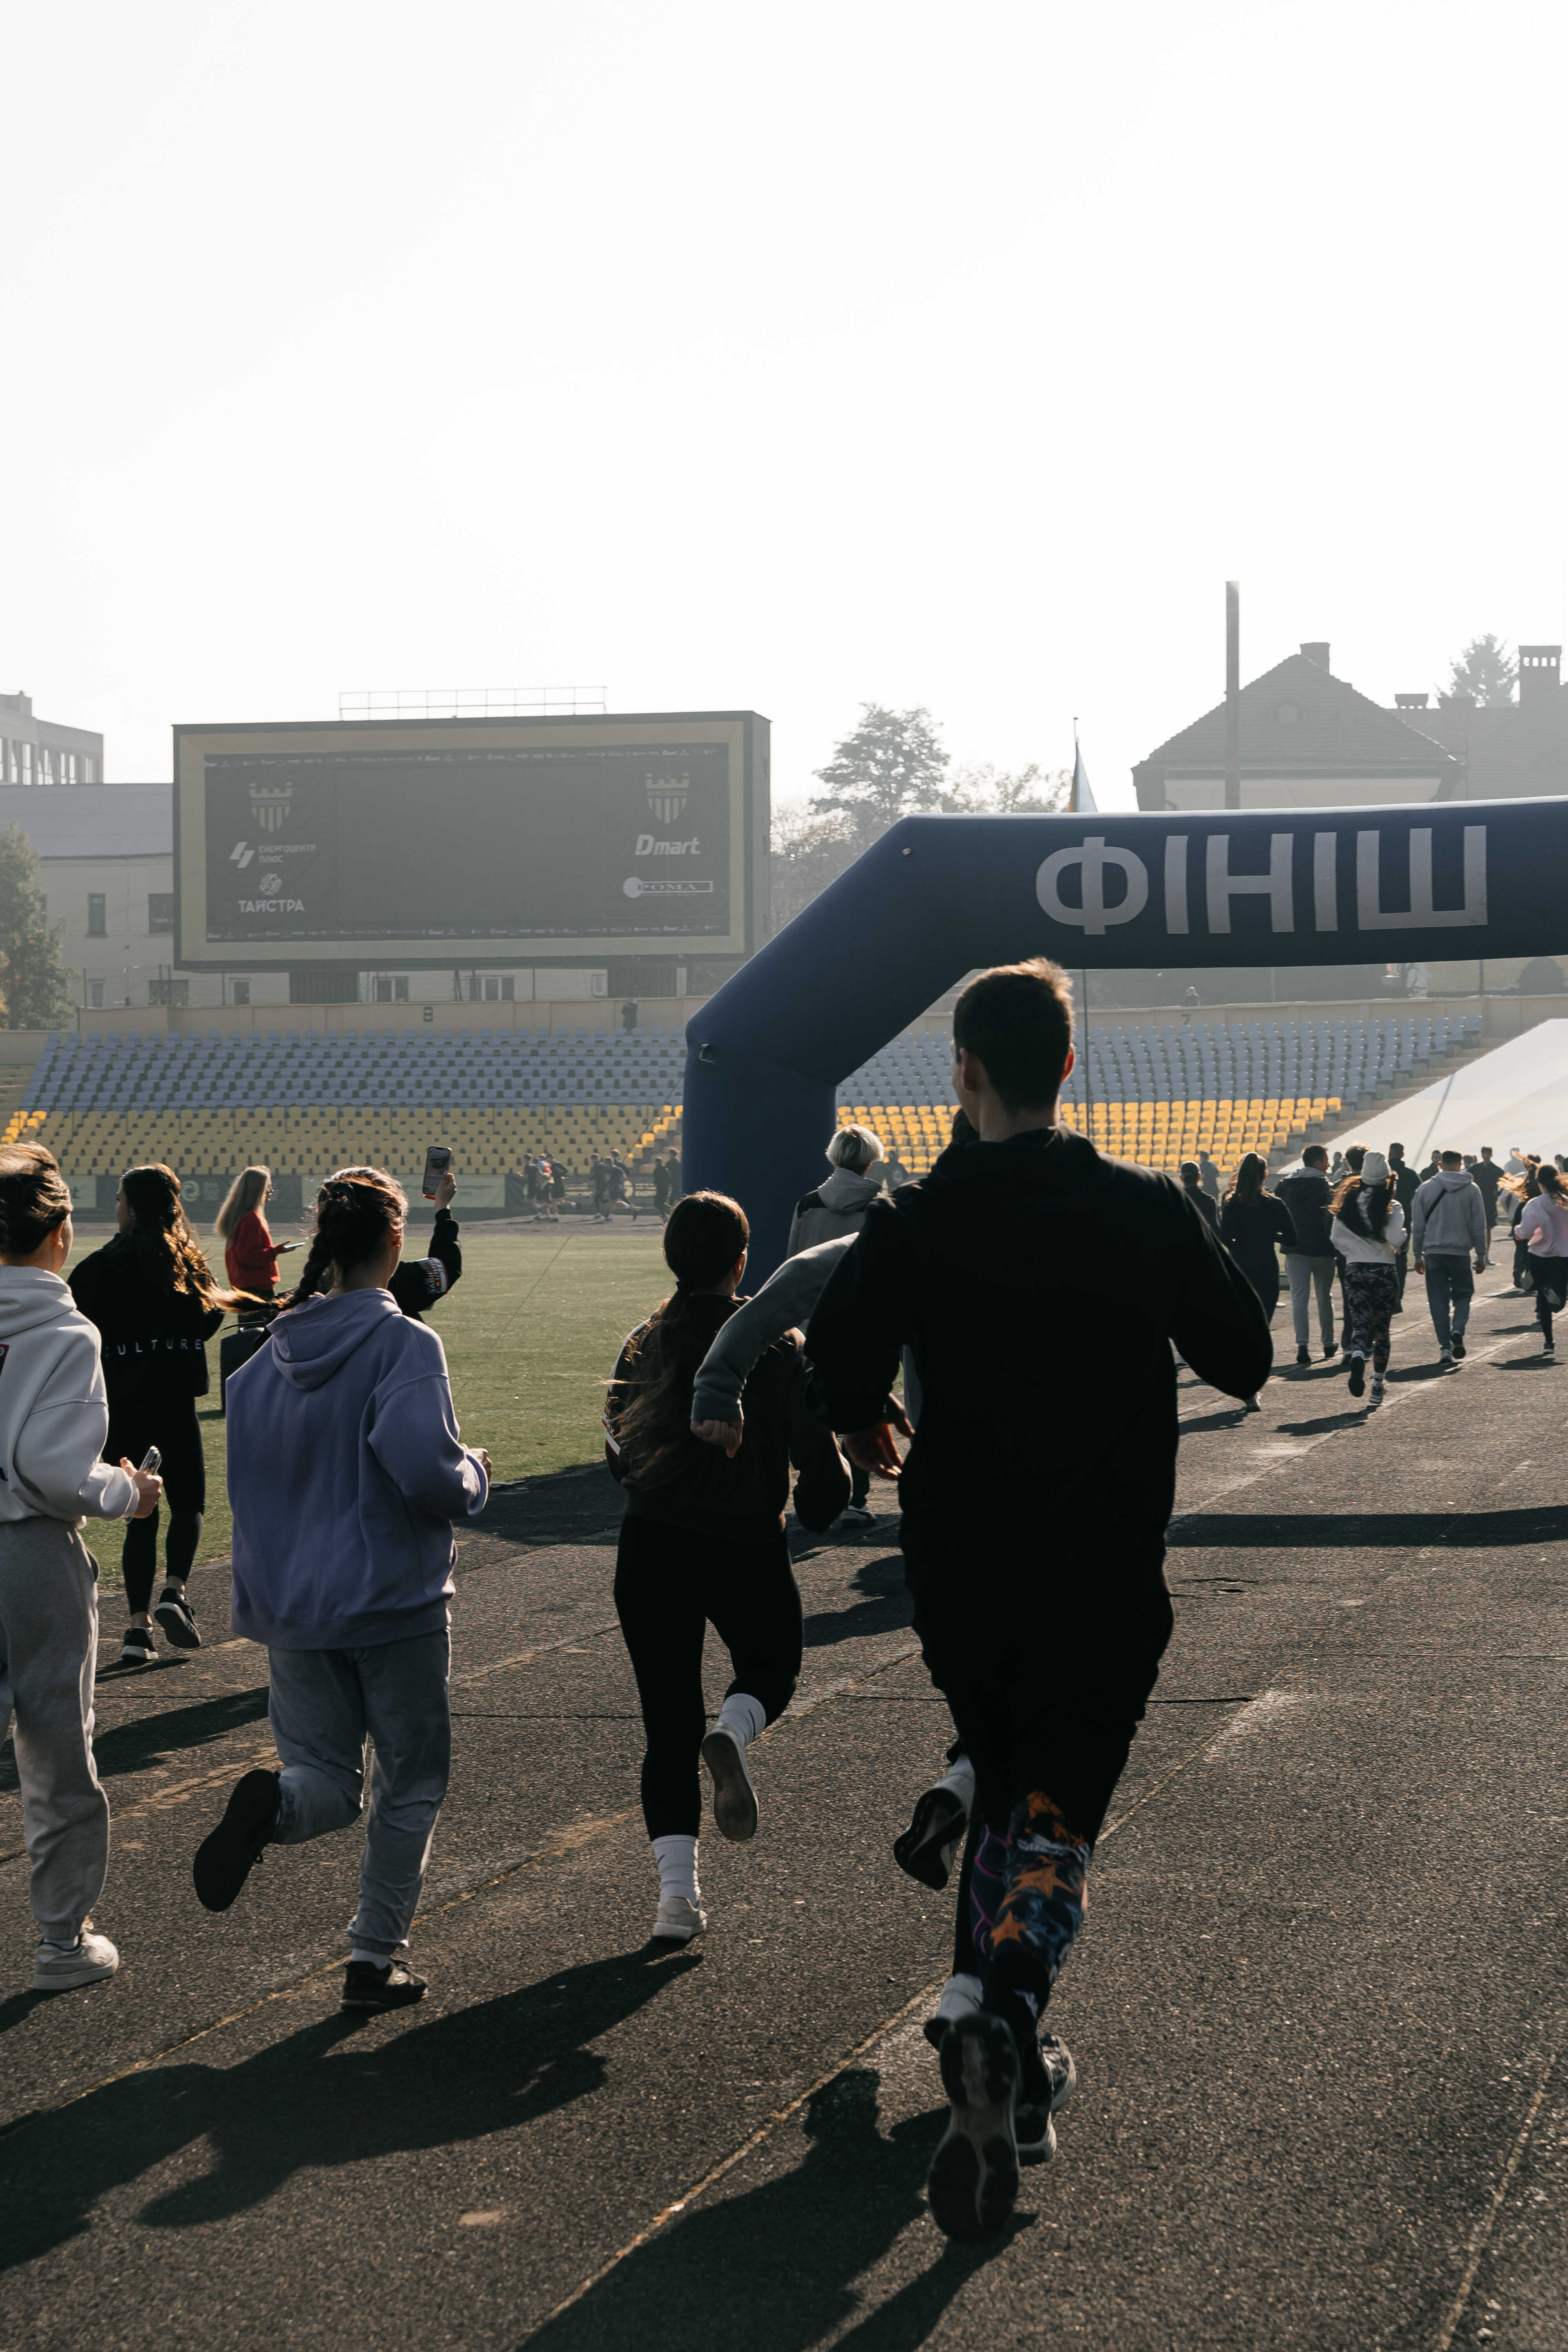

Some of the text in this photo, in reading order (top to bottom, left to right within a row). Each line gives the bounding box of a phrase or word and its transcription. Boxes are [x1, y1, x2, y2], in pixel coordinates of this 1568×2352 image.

[634, 835, 701, 855] Dmart
[1036, 825, 1488, 935] ФІНІШ
[423, 1006, 433, 1022] 8
